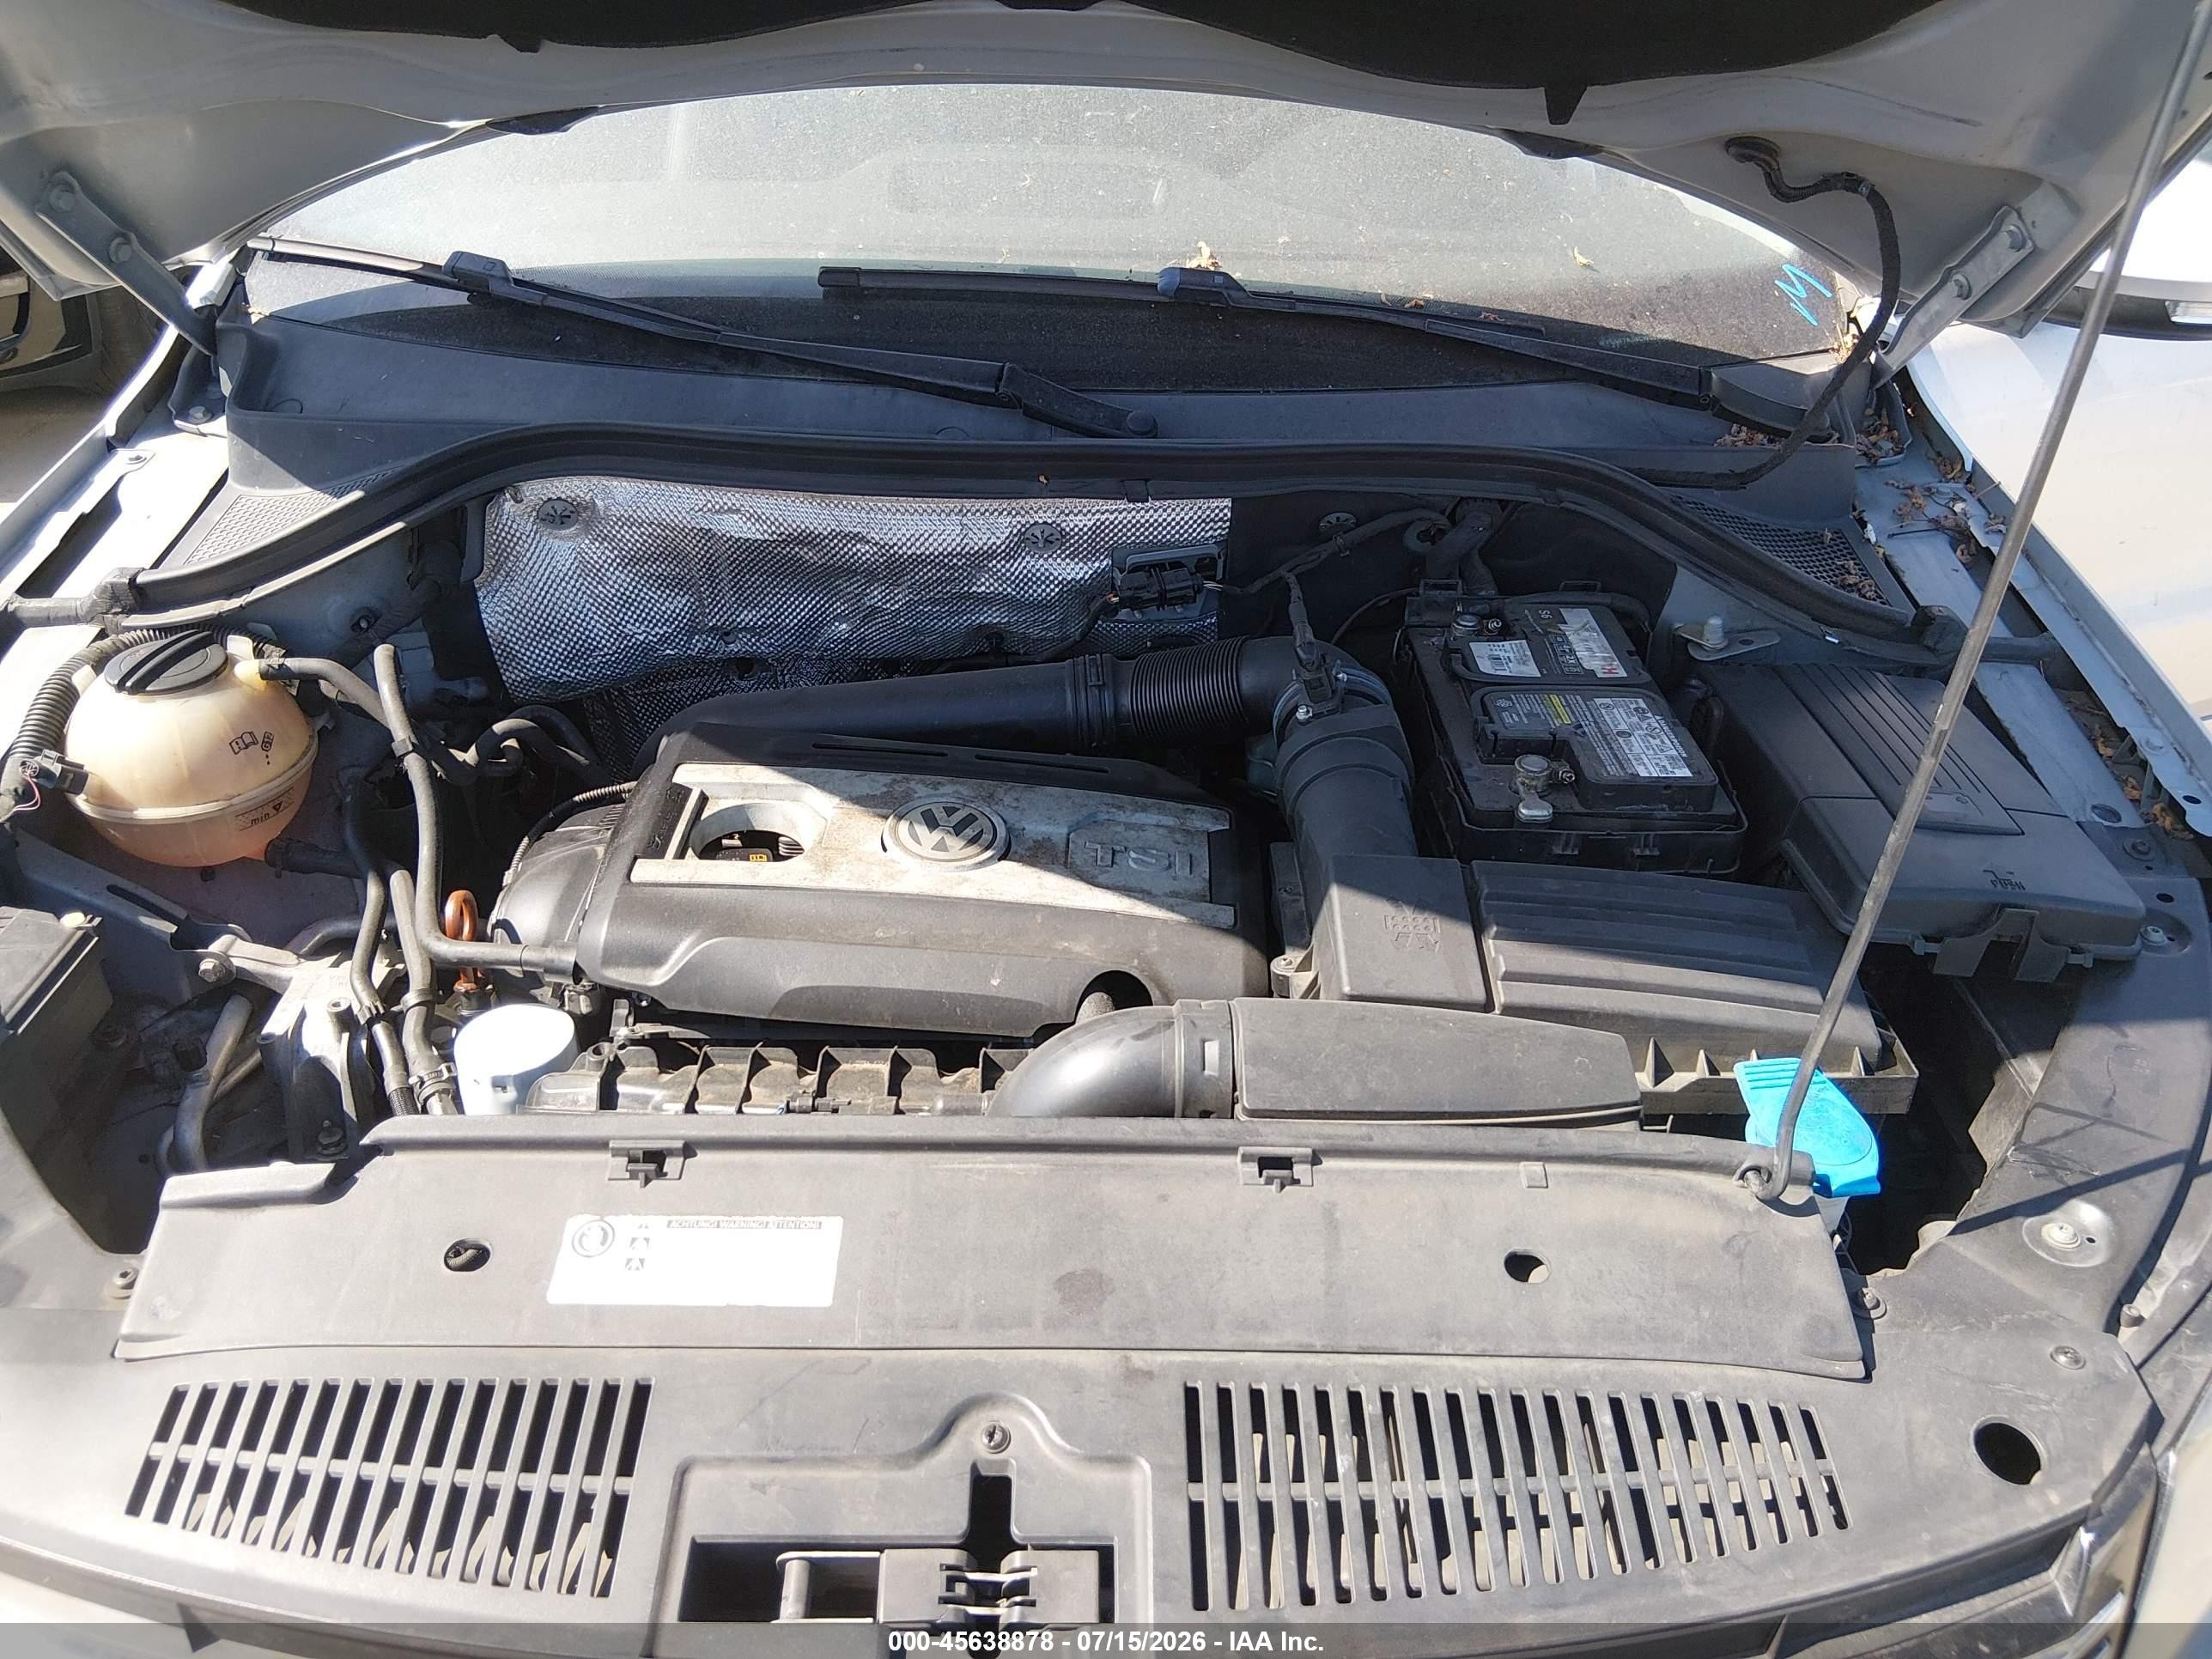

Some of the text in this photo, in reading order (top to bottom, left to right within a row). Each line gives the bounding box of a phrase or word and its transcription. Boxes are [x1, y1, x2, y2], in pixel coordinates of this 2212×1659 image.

[262, 732, 274, 750] G12
[251, 812, 270, 825] min
[1084, 841, 1193, 877] TSI
[719, 1220, 767, 1229] WARNING!
